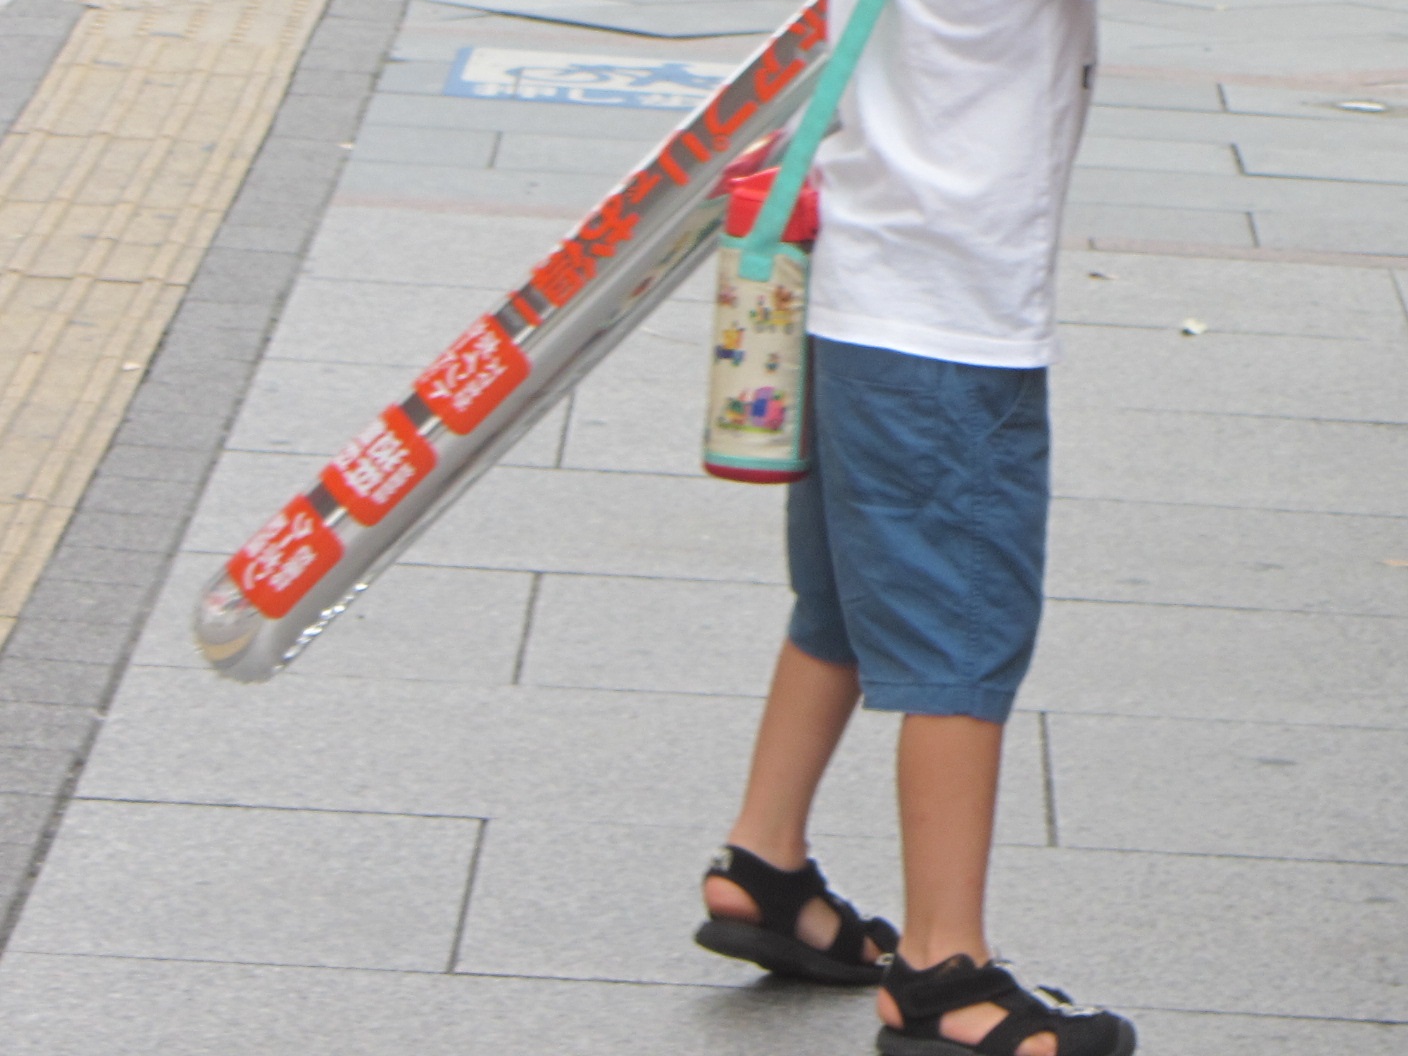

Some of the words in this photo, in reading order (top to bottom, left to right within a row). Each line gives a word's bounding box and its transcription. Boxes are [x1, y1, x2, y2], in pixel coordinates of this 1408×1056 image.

[429, 329, 500, 400] ポイント
[242, 511, 314, 590] クーポン
